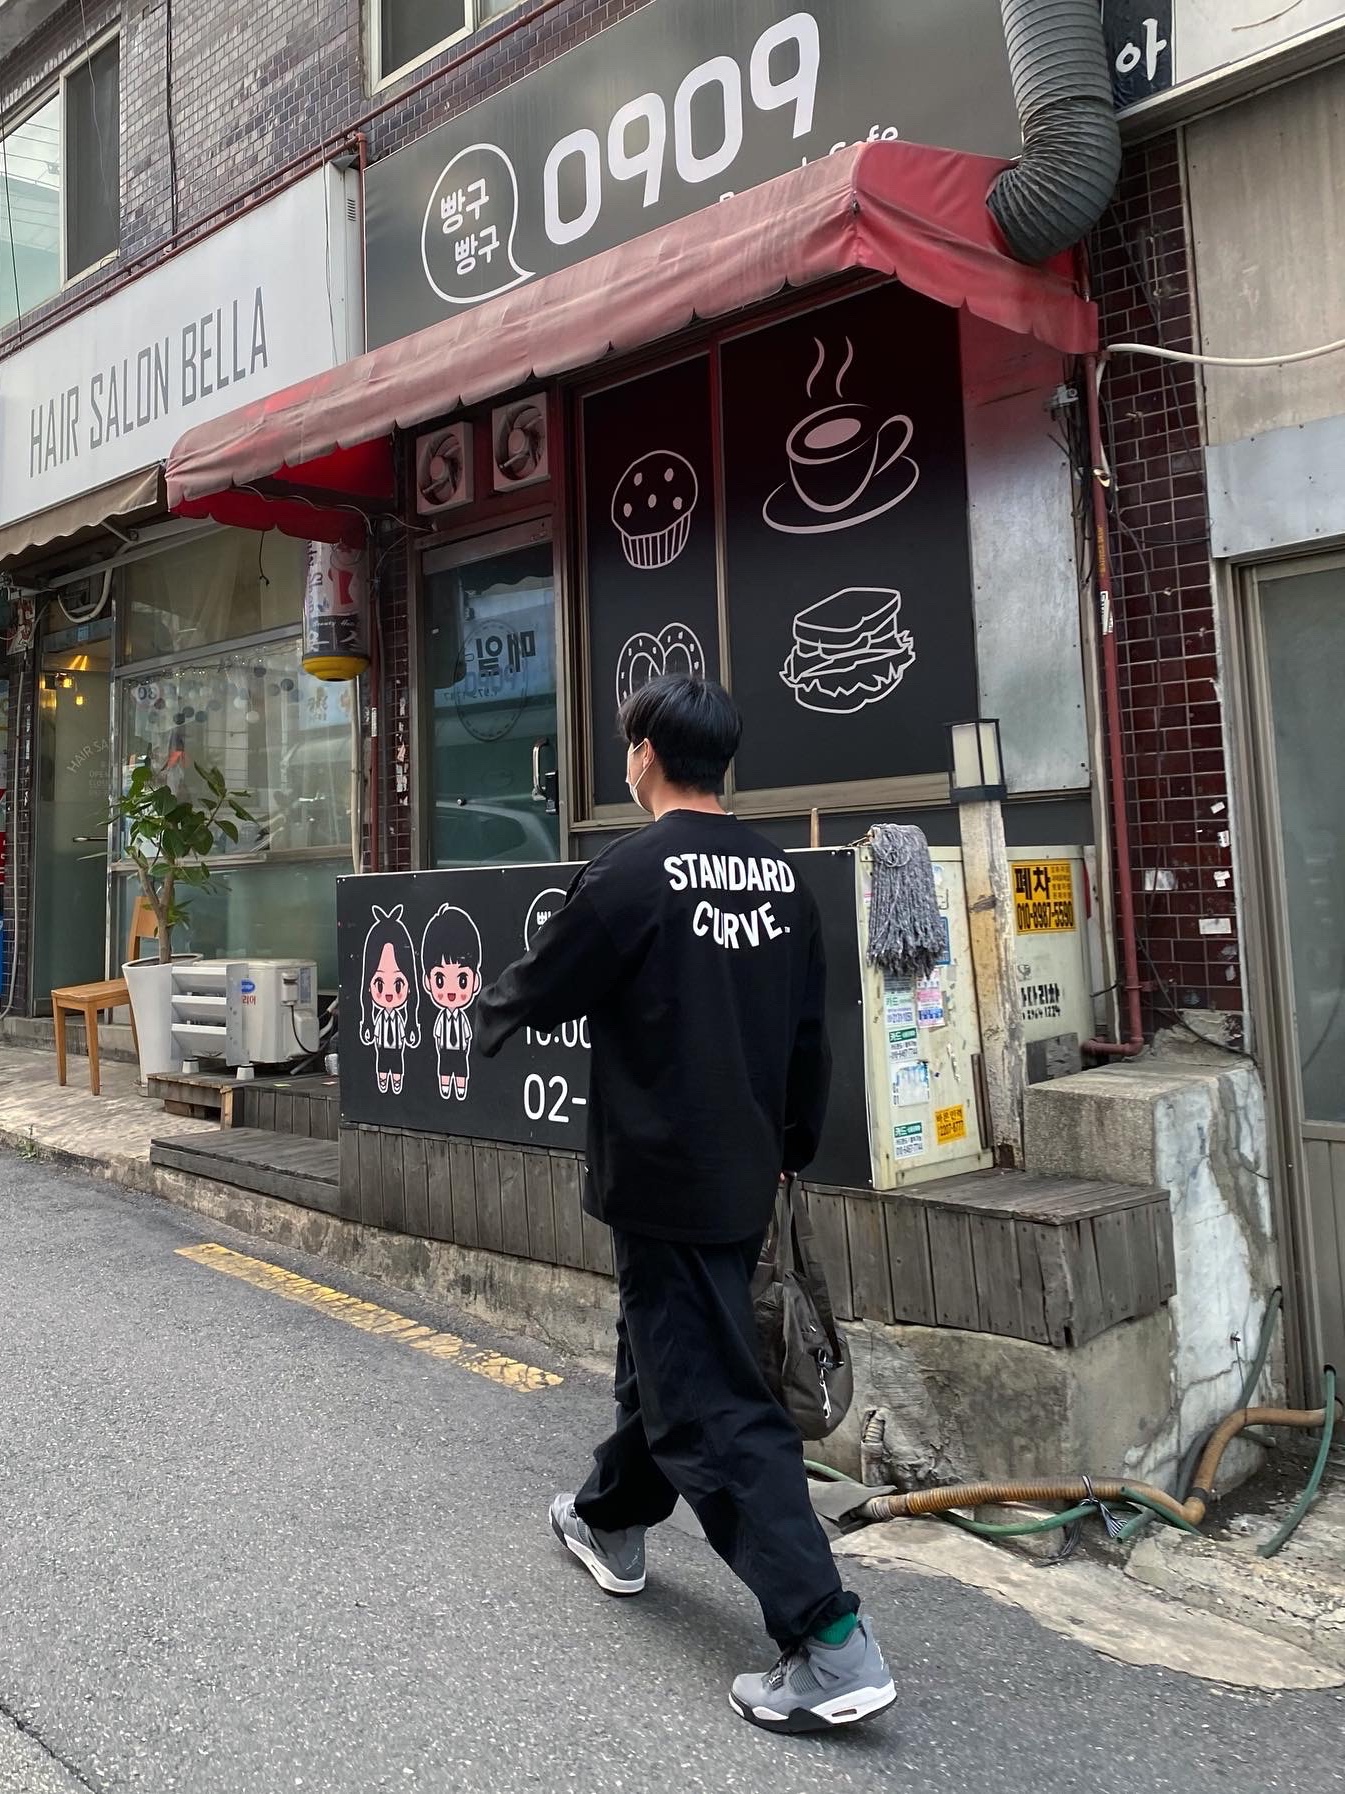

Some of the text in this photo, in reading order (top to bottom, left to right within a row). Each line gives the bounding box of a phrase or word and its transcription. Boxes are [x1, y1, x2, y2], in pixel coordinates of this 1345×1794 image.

[1115, 18, 1167, 81] 아
[544, 12, 820, 245] 0909
[441, 178, 490, 234] 빵구
[455, 224, 500, 275] 빵구
[30, 286, 268, 478] HAIR SALON BELLA
[66, 745, 93, 774] HAIR
[663, 853, 796, 893] STANDARD
[1014, 866, 1051, 901] 폐차
[692, 900, 791, 949] CURVE.
[524, 1073, 587, 1123] 02-
